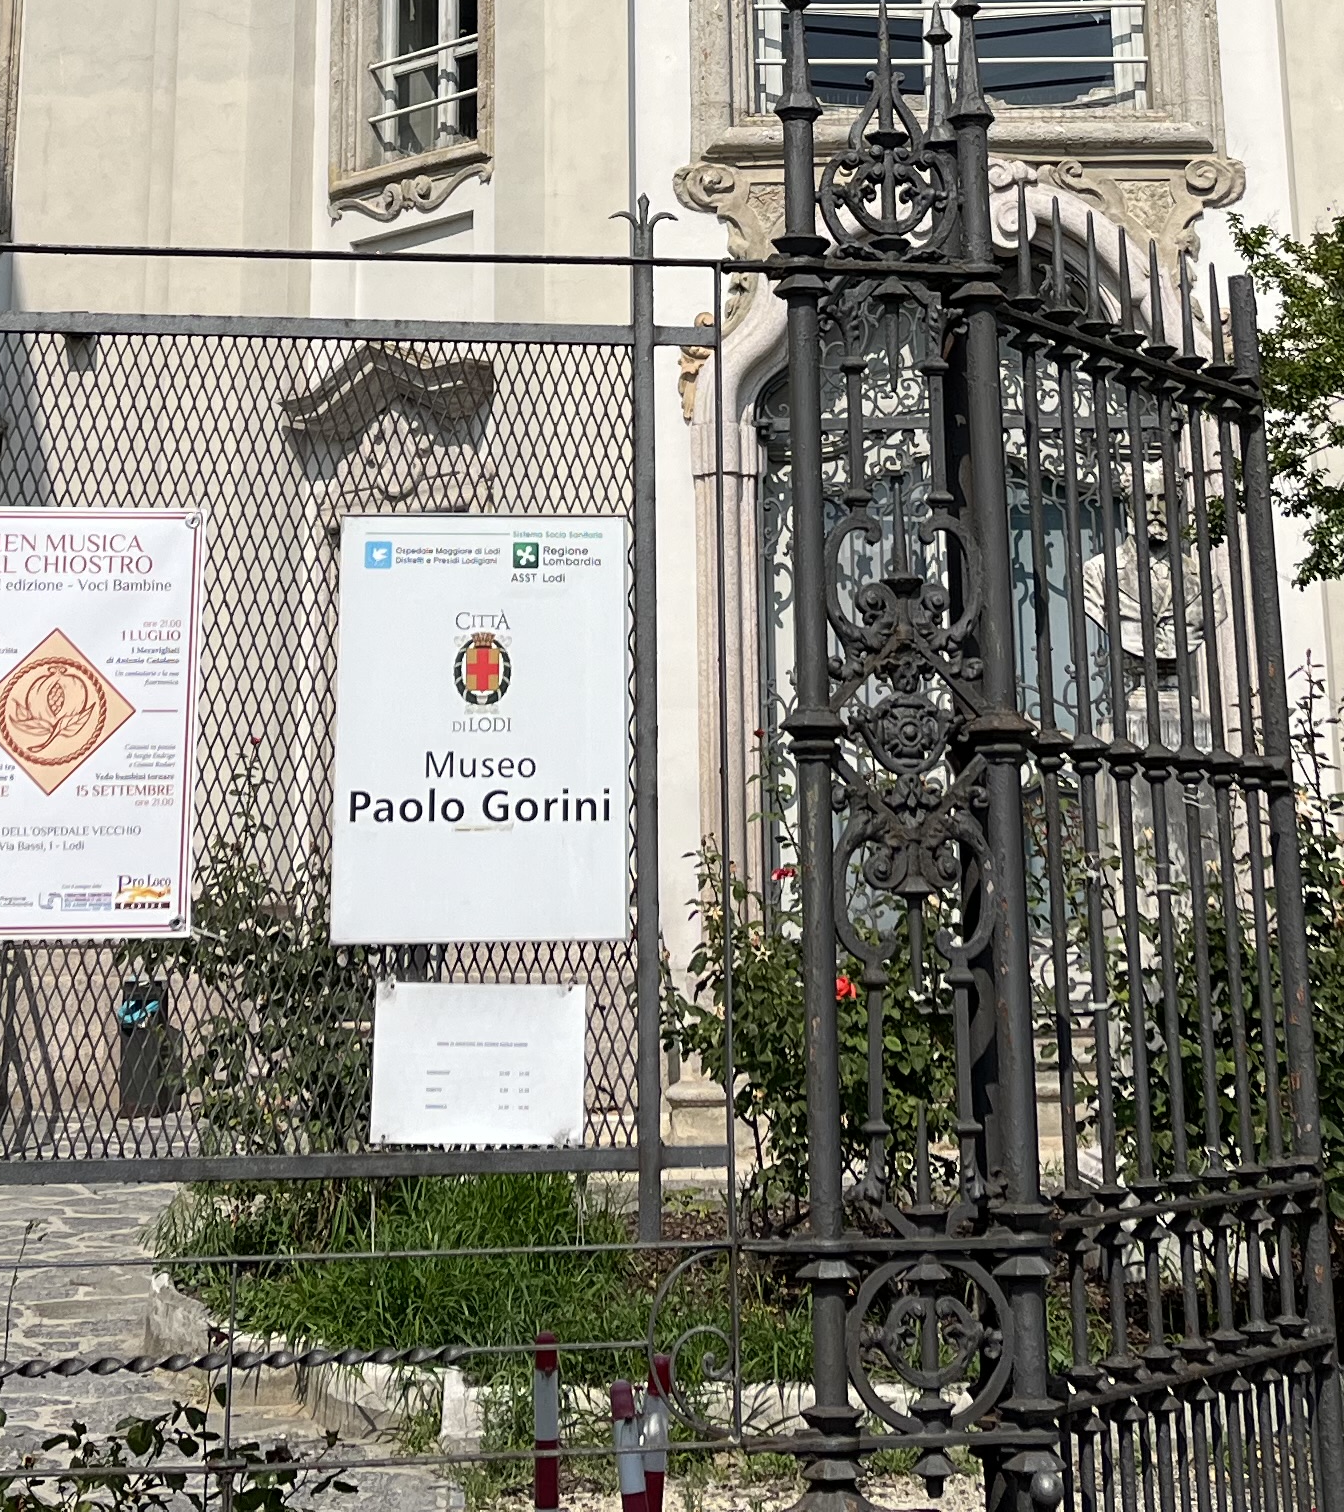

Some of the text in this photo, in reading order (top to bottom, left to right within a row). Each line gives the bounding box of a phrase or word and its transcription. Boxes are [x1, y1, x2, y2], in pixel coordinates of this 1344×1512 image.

[46, 533, 144, 553] MUSICA
[435, 546, 473, 557] Maggiore
[474, 546, 482, 555] di
[484, 546, 500, 555] Lodi
[542, 545, 589, 557] Regione
[24, 554, 153, 574] CHIOSTRO
[542, 556, 602, 567] Lombardia
[511, 573, 566, 583] ASST Lodi
[5, 578, 63, 592] edizione
[77, 578, 108, 591] Voci
[113, 578, 172, 592] Bambine
[130, 629, 181, 642] LUGLIO
[452, 717, 512, 733] DI LODI
[425, 750, 537, 779] Museo
[76, 784, 174, 797] 15 SETTEMBRE
[349, 787, 611, 823] Paolo Gorini
[92, 825, 142, 837] VECCHIO
[0, 841, 14, 851] Via
[63, 841, 84, 851] Lodi
[147, 873, 171, 888] Loco
